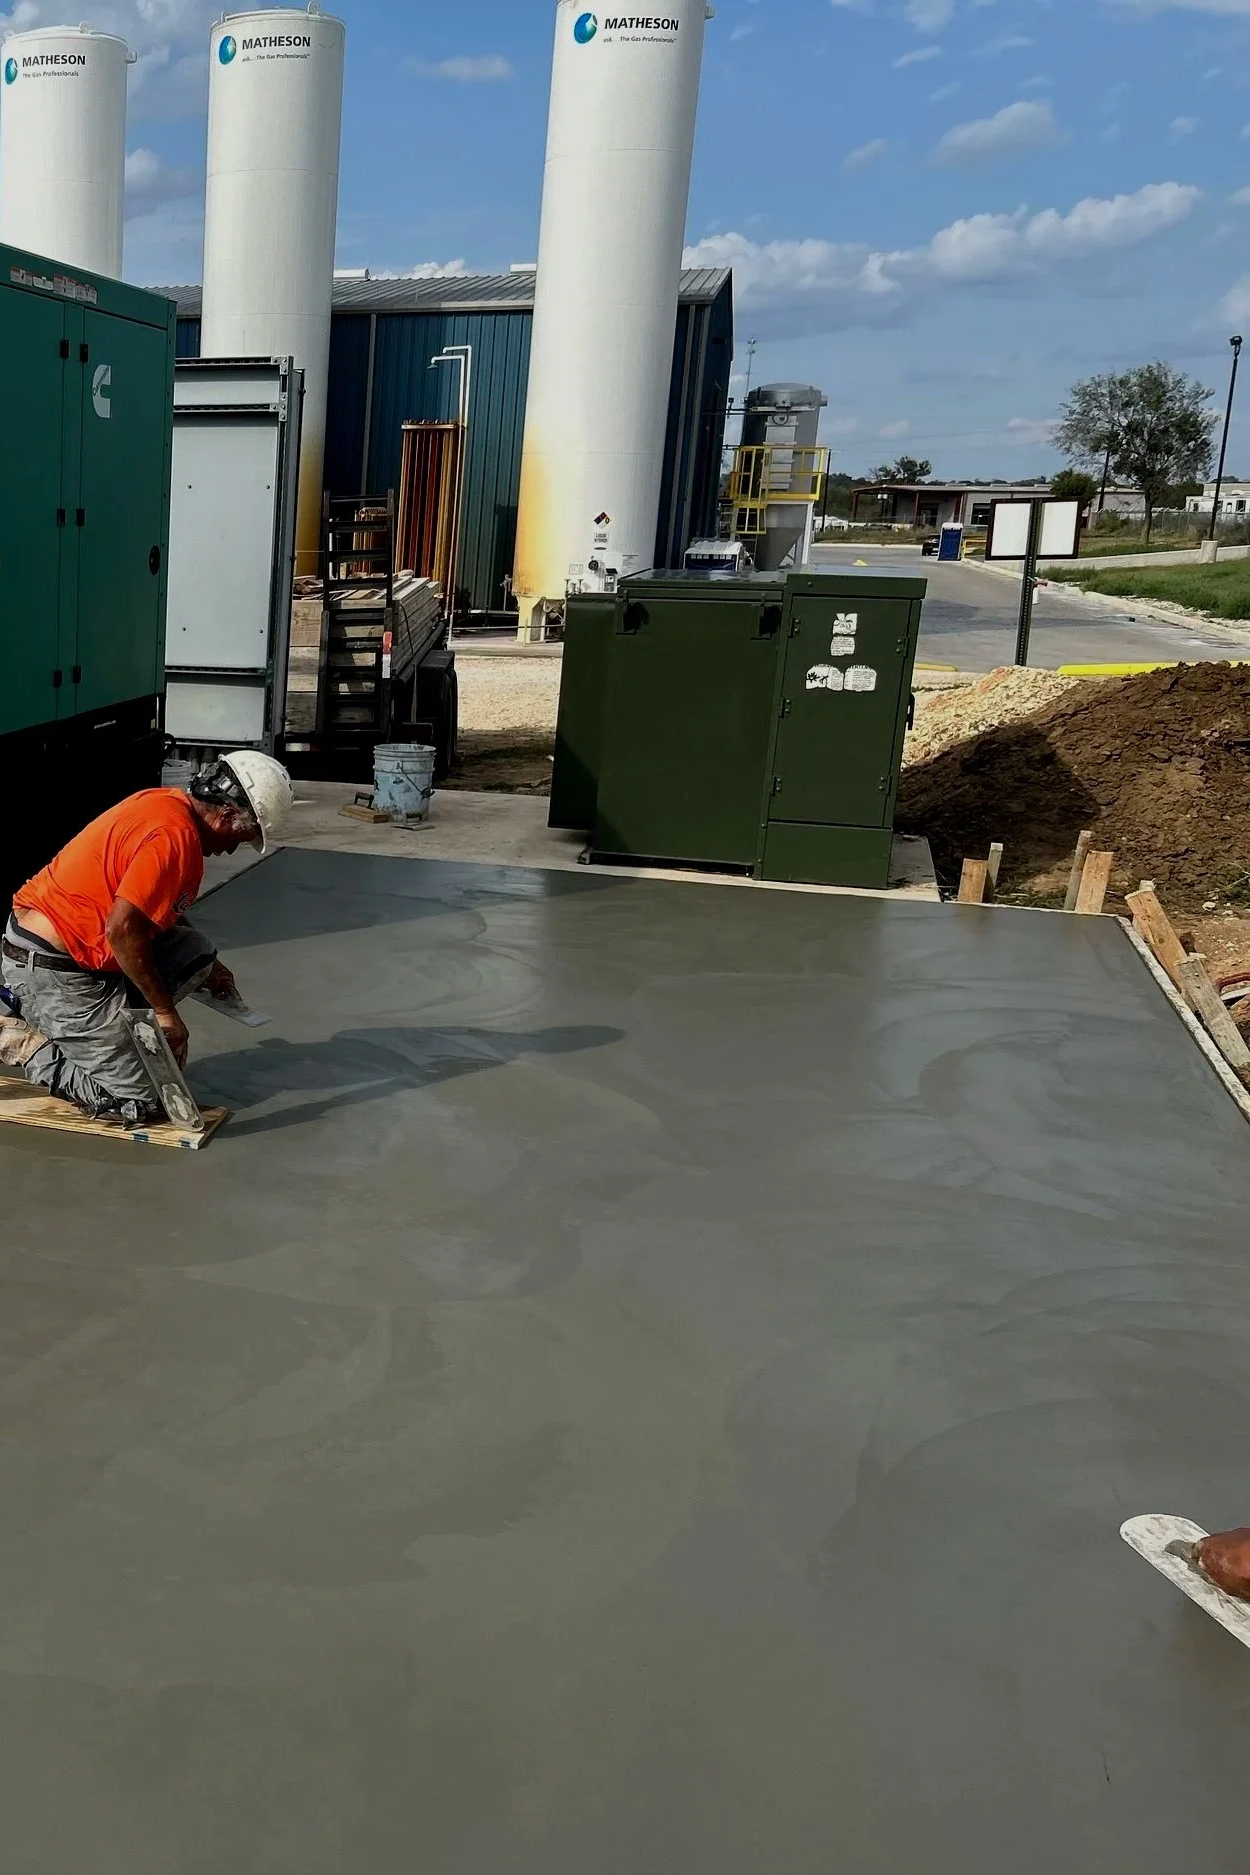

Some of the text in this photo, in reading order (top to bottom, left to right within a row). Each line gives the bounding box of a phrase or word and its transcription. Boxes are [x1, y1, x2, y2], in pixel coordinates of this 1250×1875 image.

[604, 17, 679, 31] MATHESON
[242, 35, 311, 50] MATHESON
[22, 54, 86, 68] MATHESON
